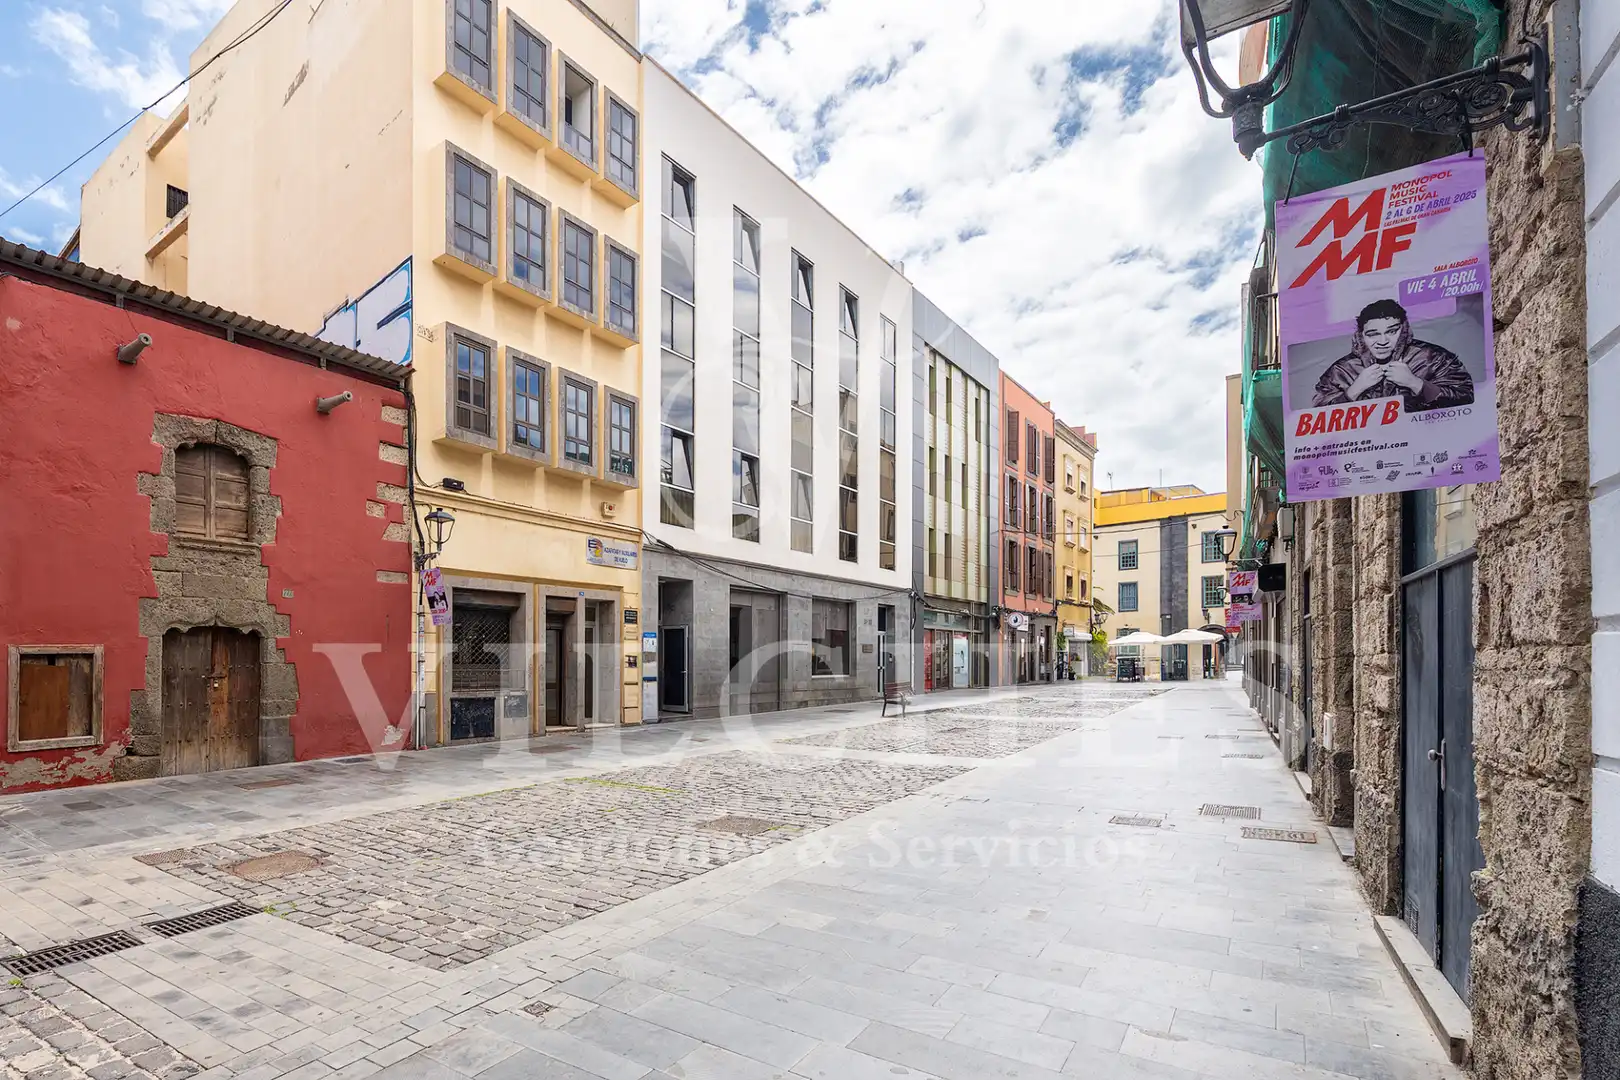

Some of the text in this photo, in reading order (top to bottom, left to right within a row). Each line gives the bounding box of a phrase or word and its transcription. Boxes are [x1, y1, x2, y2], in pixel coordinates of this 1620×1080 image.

[1391, 170, 1452, 192] MONOPOL
[1388, 191, 1438, 209] FESTIVAL
[1390, 185, 1427, 200] MUSIC
[1385, 189, 1477, 220] 2 AL 6 DE ABRIL 2025
[1433, 264, 1447, 272] SALA
[1407, 268, 1477, 295] VIE 4 ABRIL
[1295, 400, 1400, 437] BARRY B
[1293, 441, 1408, 460] monopolmusicfestival.com
[1294, 445, 1311, 454] info
[1322, 440, 1358, 451] entradas
